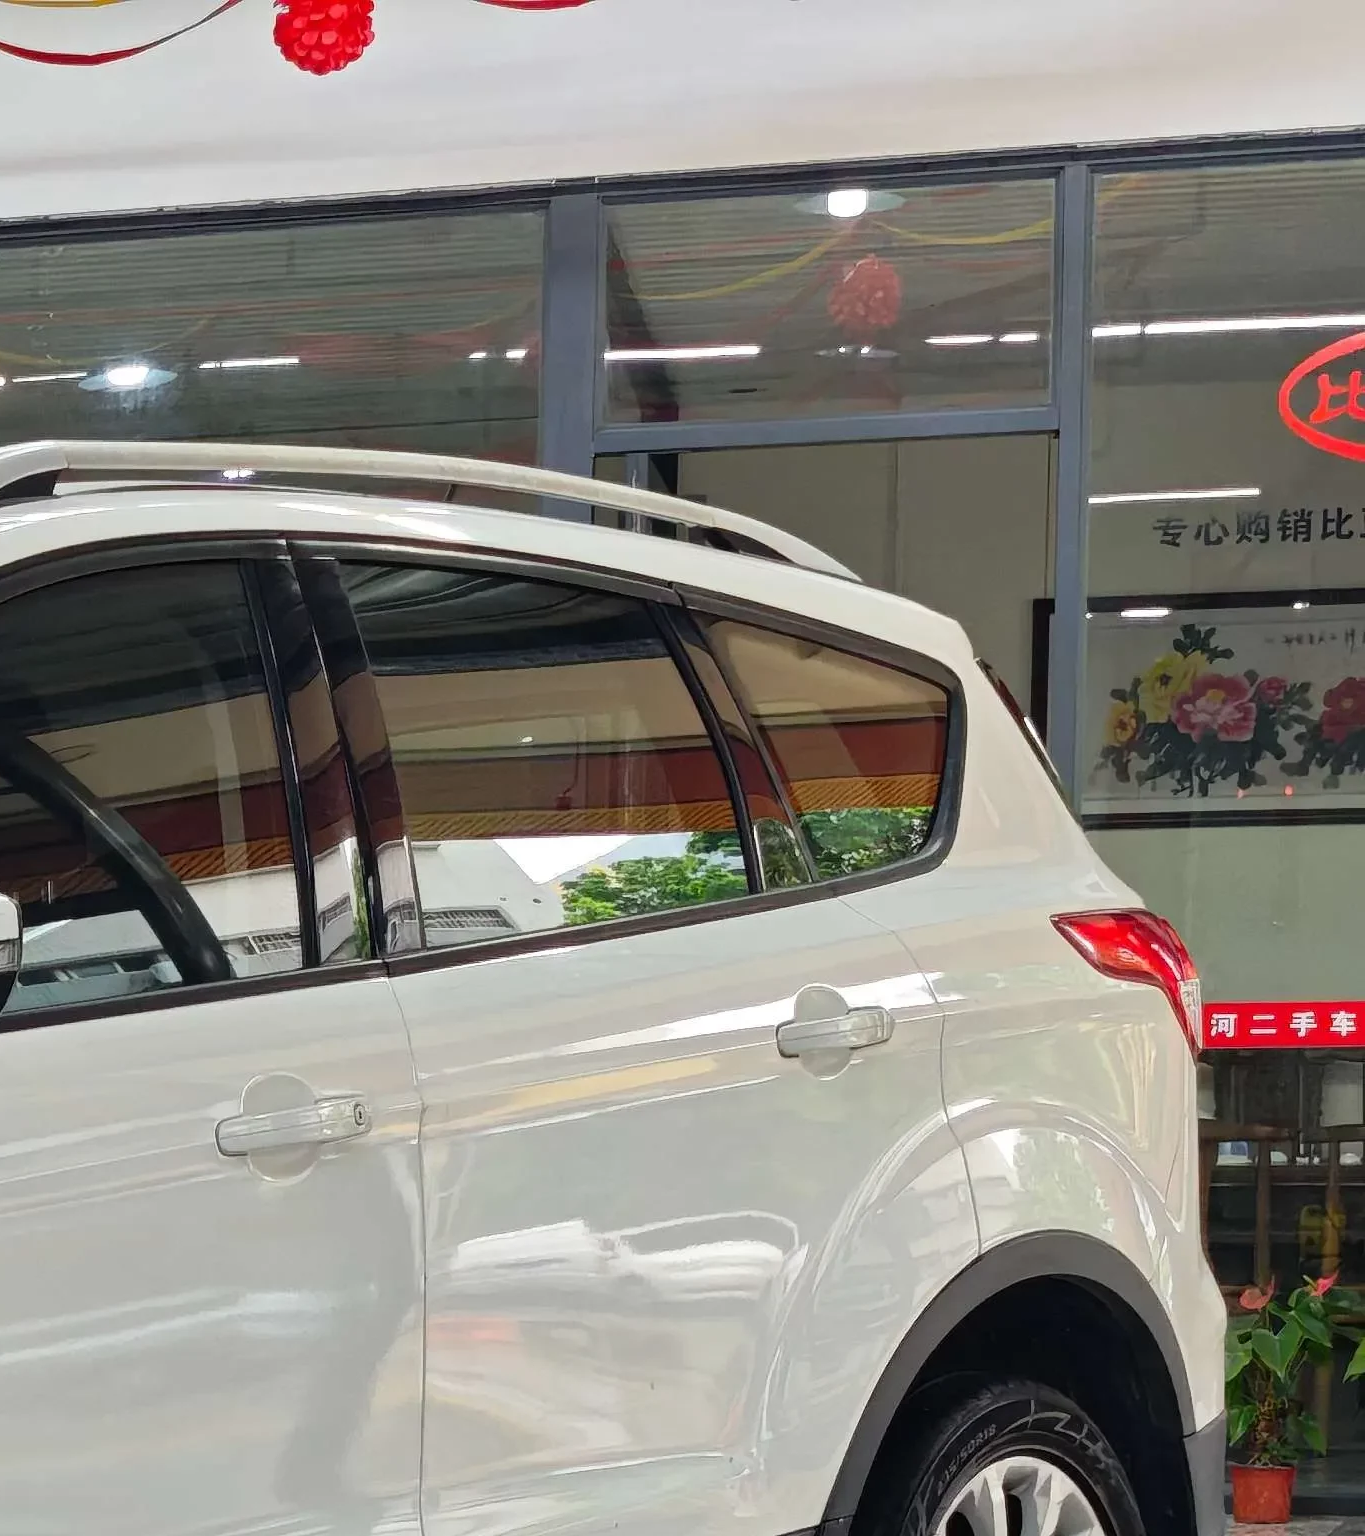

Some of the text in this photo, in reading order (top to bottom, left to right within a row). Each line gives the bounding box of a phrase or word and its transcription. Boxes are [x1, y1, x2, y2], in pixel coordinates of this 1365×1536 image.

[1153, 507, 1365, 547] 专心购销比
[1210, 1010, 1357, 1038] 河二手车
